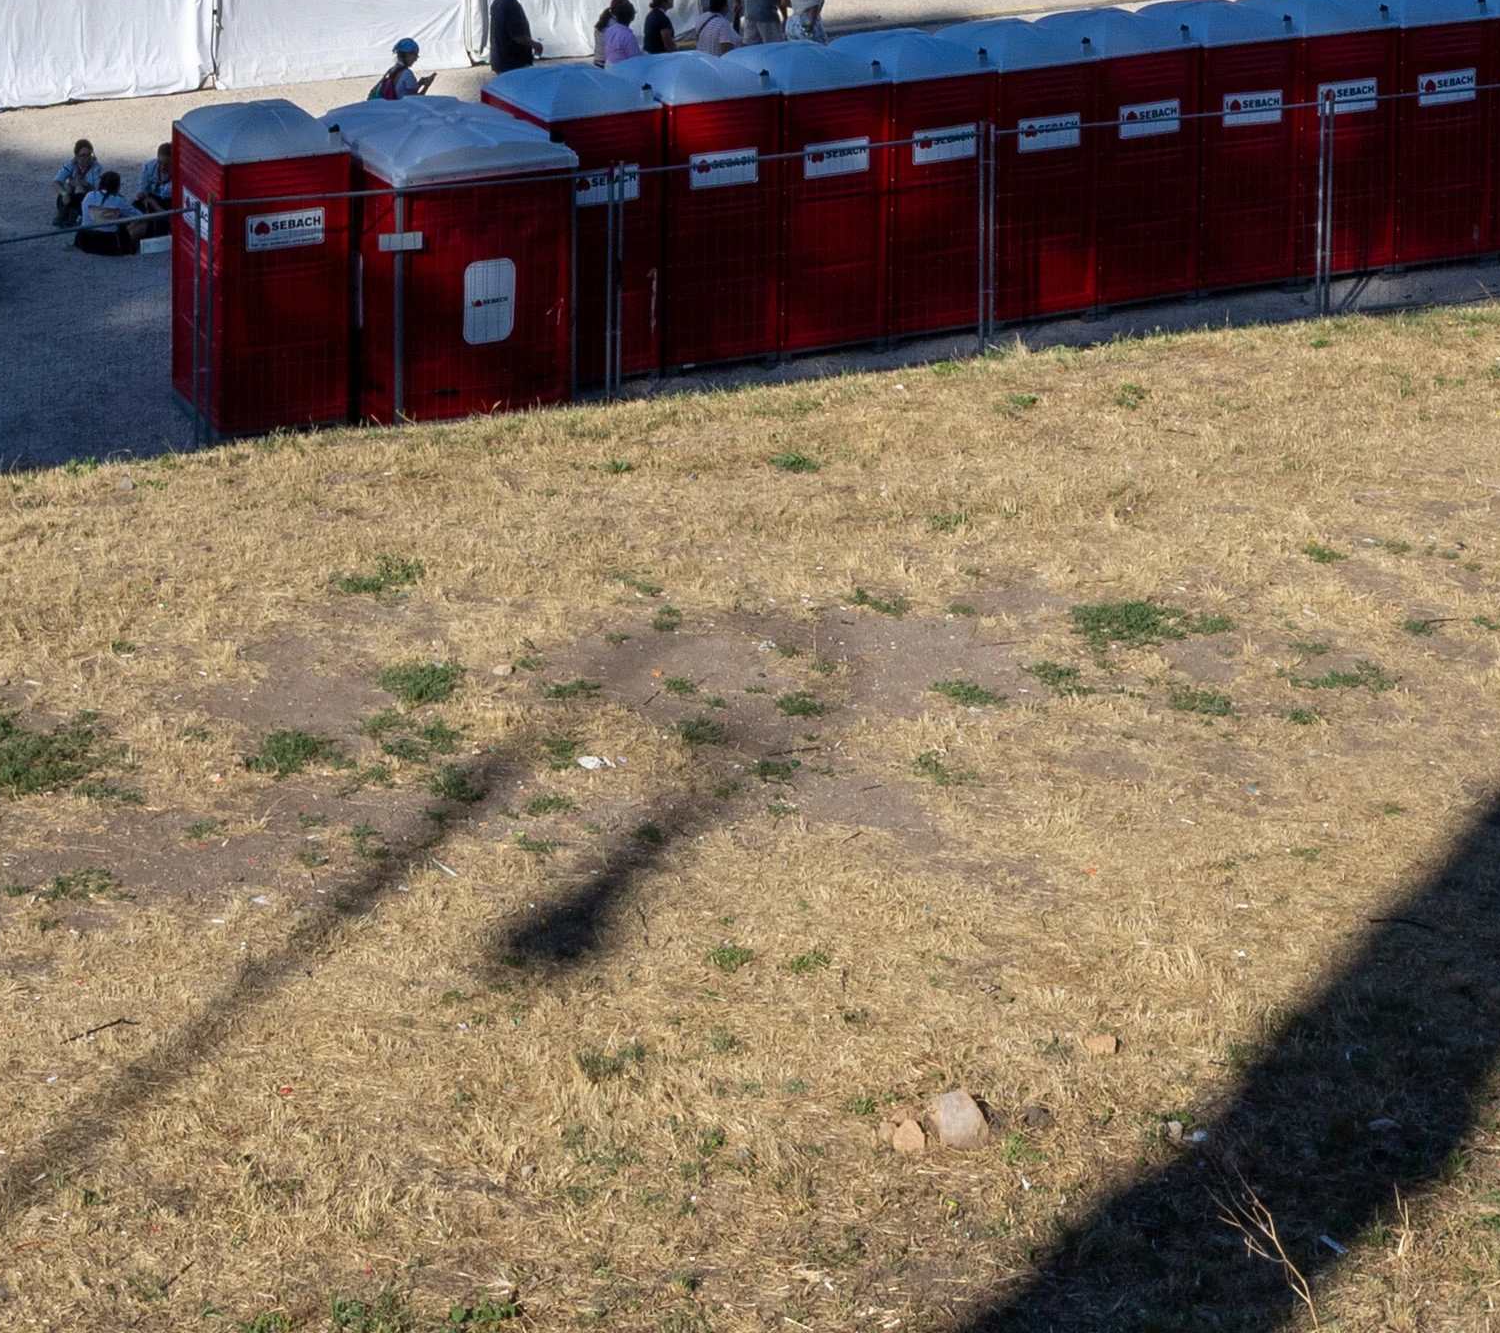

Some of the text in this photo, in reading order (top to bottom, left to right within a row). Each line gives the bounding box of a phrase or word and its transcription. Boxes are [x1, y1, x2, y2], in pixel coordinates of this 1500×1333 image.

[1437, 76, 1474, 88] SEBACH
[1337, 85, 1375, 98] SEBACH
[1242, 98, 1280, 110] SEBACH
[1139, 107, 1177, 120] SEBACH
[824, 146, 866, 160] SEBACH
[711, 156, 756, 170] SEBACH
[592, 172, 636, 188] SEACH
[272, 216, 321, 232] SEBACH
[483, 296, 508, 304] SEBACH
